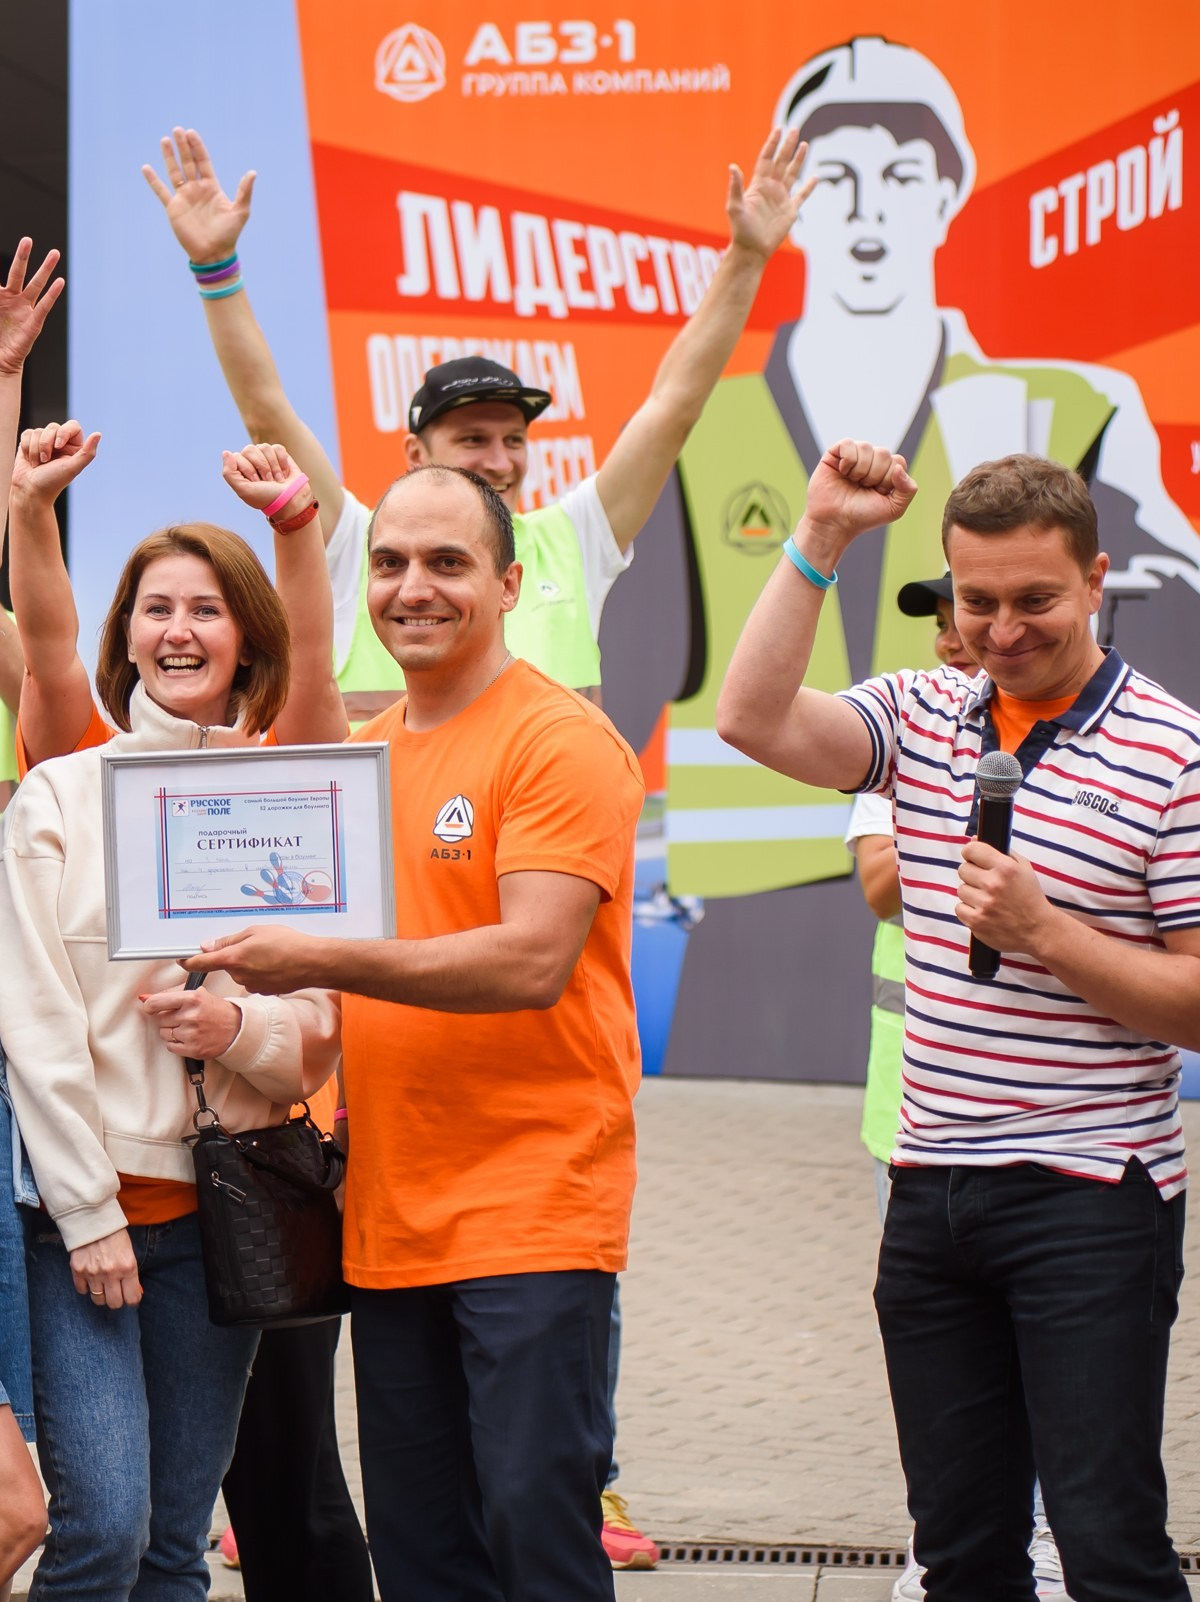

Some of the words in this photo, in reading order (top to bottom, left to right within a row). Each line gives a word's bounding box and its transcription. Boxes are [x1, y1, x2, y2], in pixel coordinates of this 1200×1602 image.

[462, 72, 568, 97] ГРУППА
[572, 63, 731, 95] КОМПАНИЙ
[1029, 109, 1183, 269] СТРОЙ
[396, 190, 727, 318] ЛИДЕРСТВО
[190, 798, 231, 807] РУССКОЕ
[207, 807, 231, 816] ПОЛЕ
[198, 827, 247, 837] подарочный
[197, 836, 303, 850] СЕРТИФИКАТ
